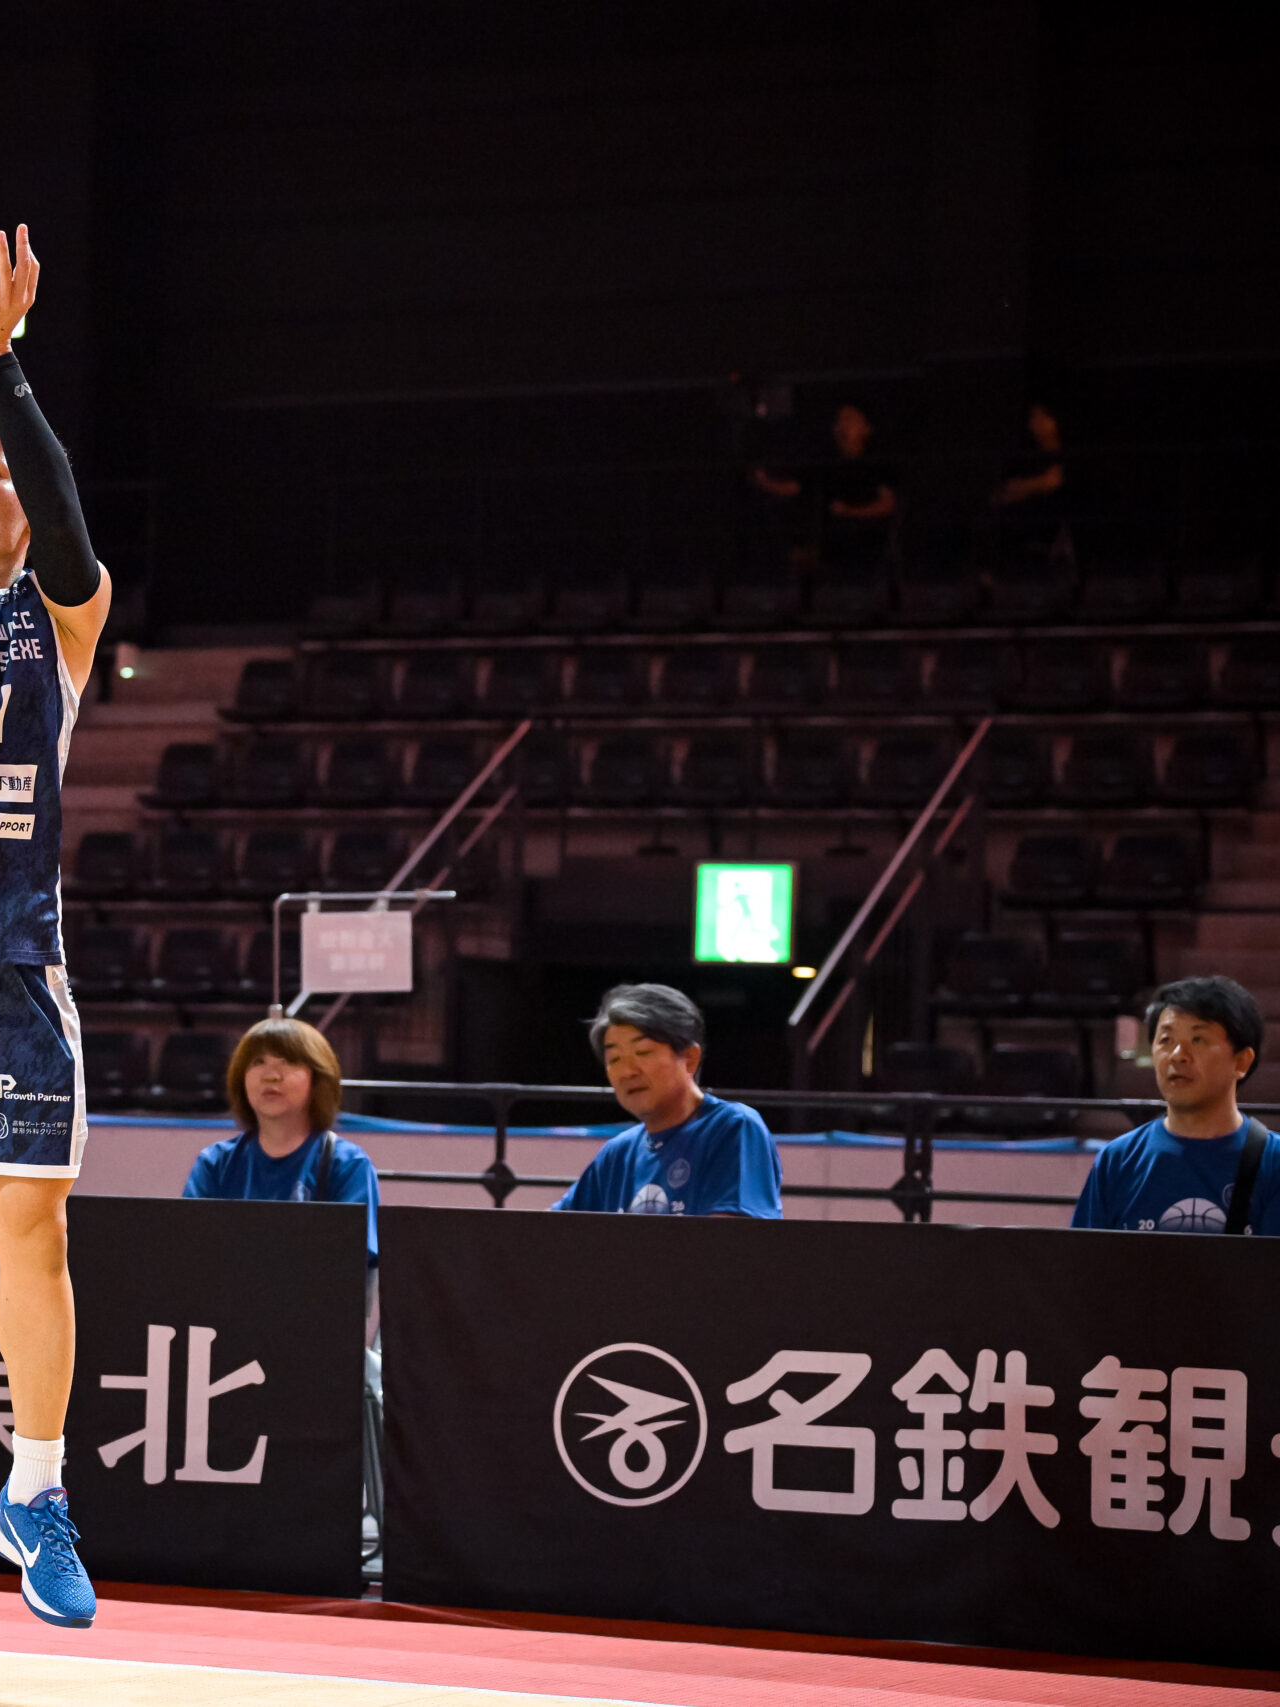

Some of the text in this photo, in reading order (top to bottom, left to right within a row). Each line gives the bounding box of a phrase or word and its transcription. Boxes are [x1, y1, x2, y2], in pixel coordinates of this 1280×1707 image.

[3, 1091, 71, 1102] Growth Partner
[723, 1348, 1280, 1541] 名鉄観
